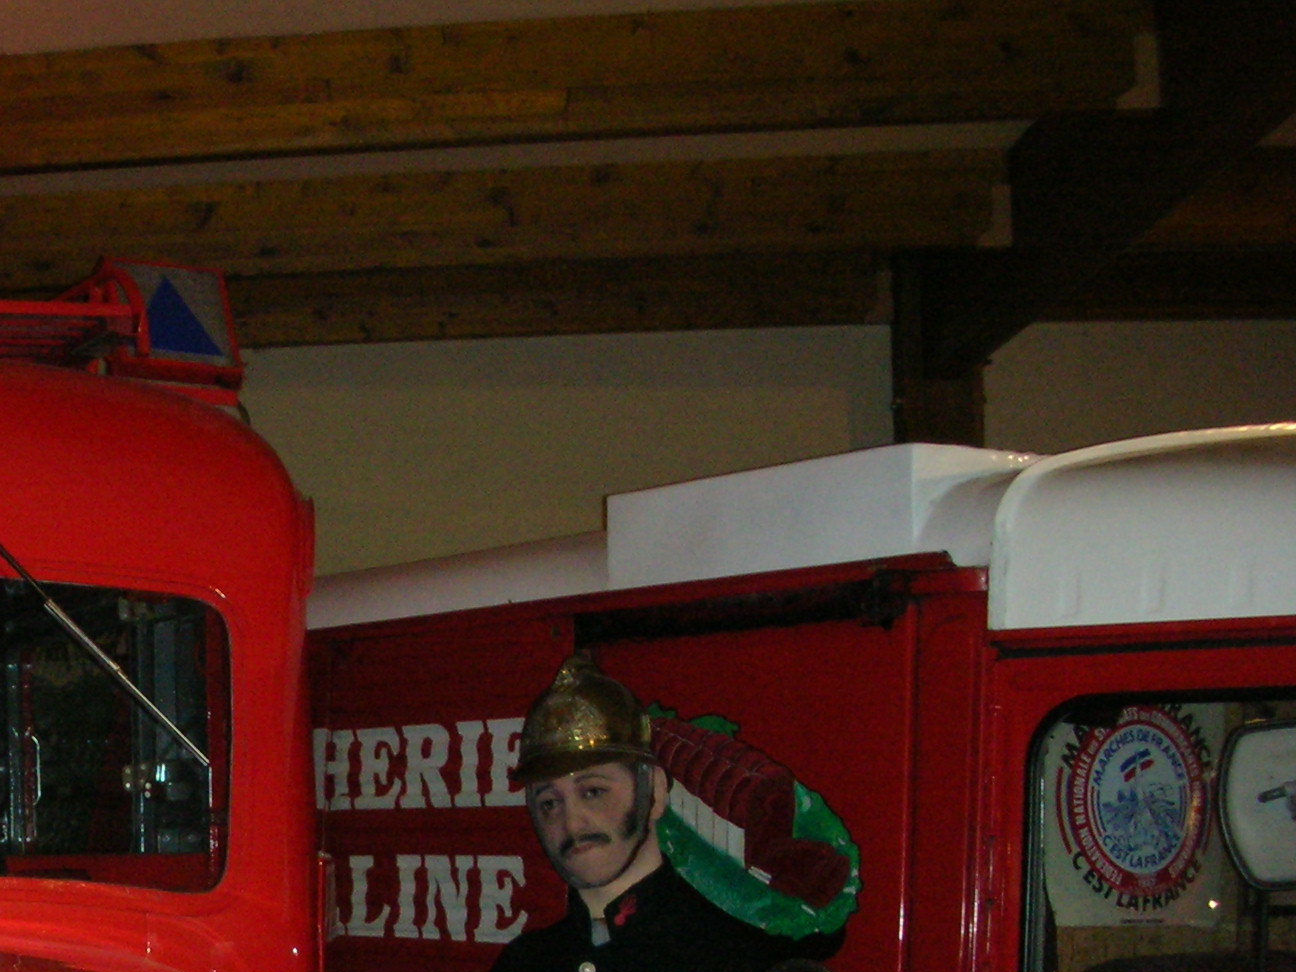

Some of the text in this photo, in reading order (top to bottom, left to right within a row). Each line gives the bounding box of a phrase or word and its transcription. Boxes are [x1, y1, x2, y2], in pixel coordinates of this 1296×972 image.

[312, 717, 527, 811] HERIE
[1074, 754, 1090, 827] NATIONALE
[1093, 729, 1134, 786] MARCHES
[1136, 728, 1150, 742] DE
[1151, 733, 1185, 780] FRANCE
[325, 853, 529, 944] LINE
